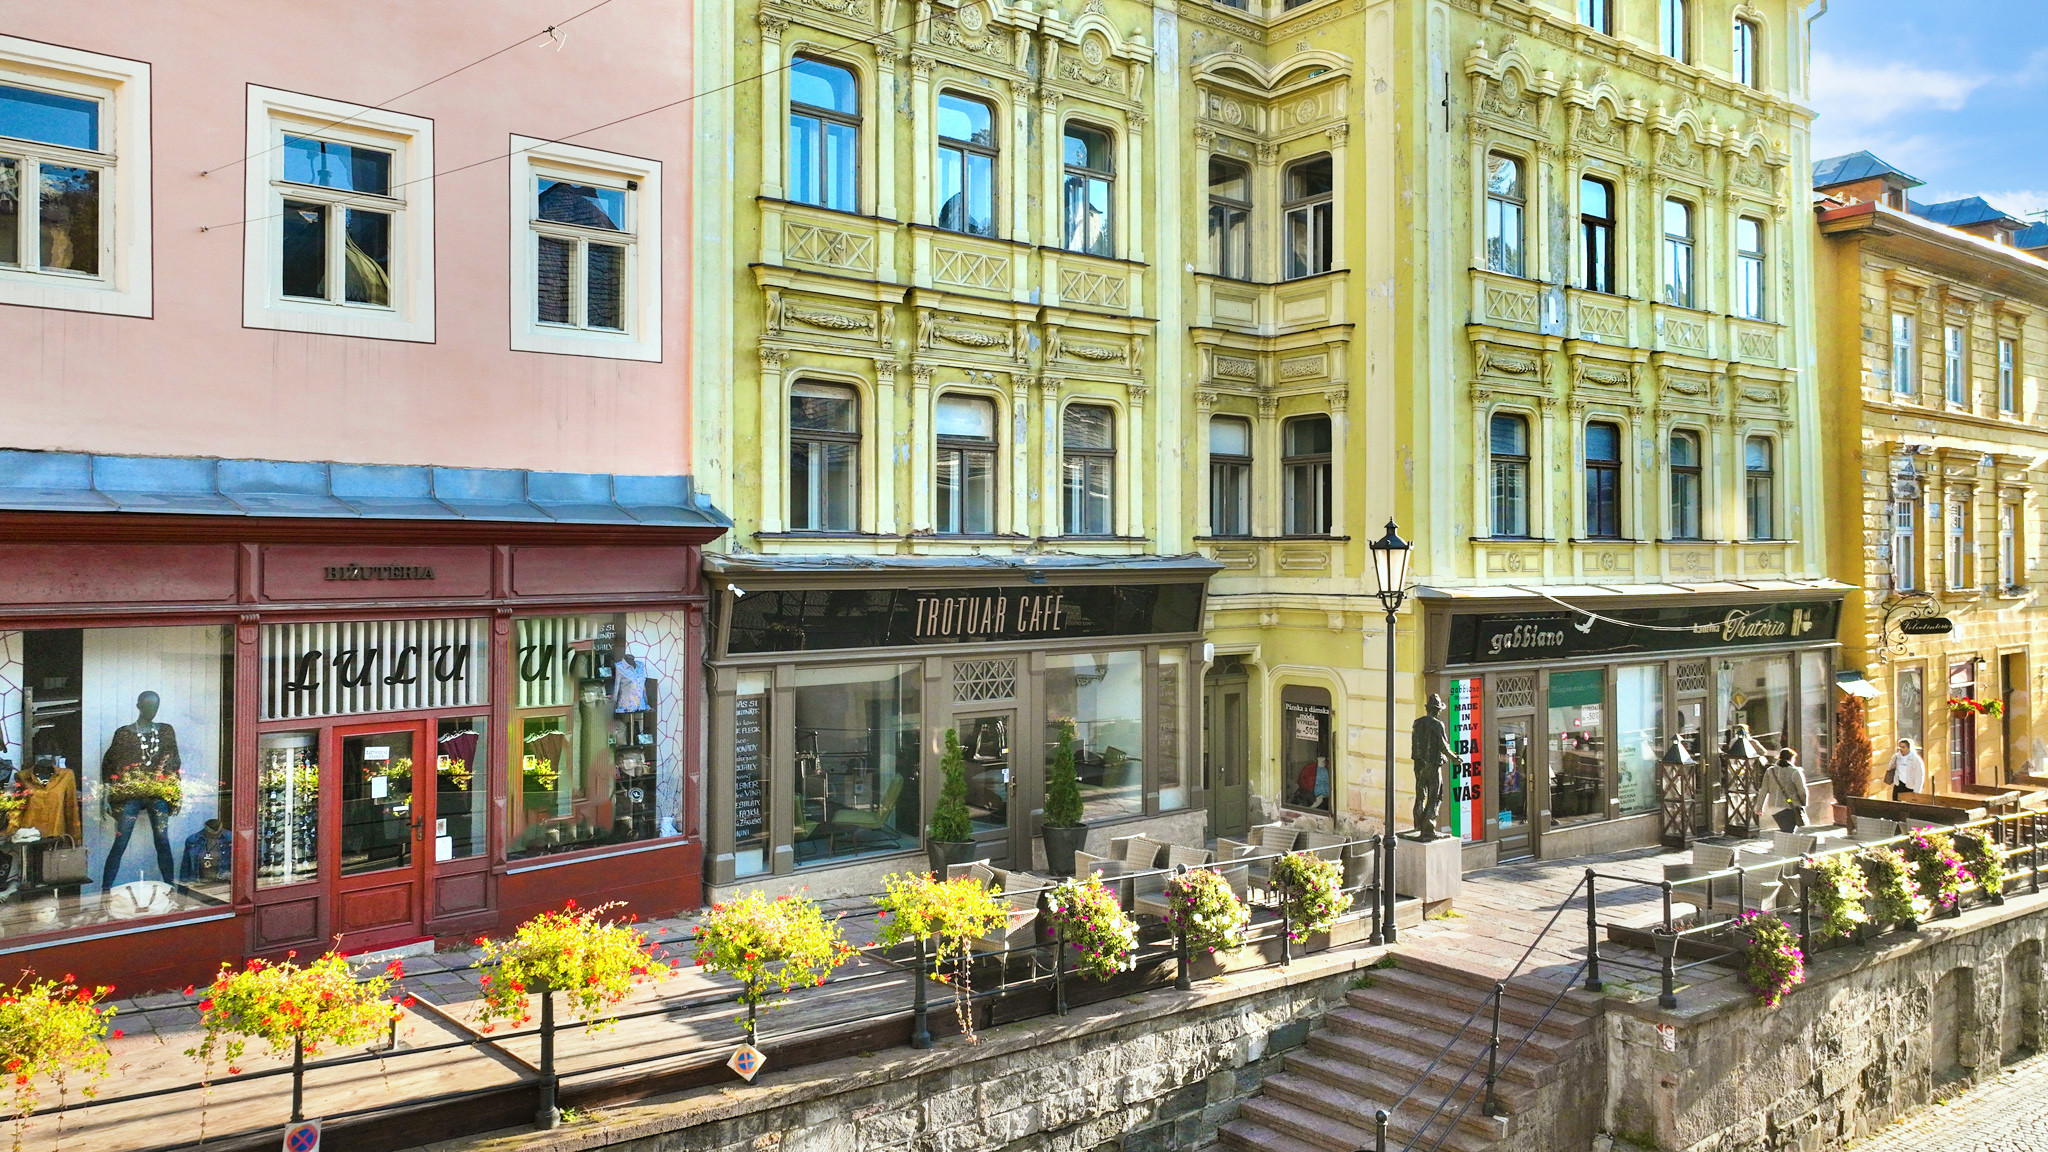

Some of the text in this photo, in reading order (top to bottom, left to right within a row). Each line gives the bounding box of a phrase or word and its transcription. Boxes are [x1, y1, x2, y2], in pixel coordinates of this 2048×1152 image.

[324, 562, 436, 581] BIŽUTÉRIA
[916, 596, 1007, 637] TROTUAR
[1488, 624, 1564, 655] gabbiano
[286, 645, 468, 691] LULU
[1454, 702, 1478, 712] MADE
[1462, 713, 1471, 721] IN
[1454, 722, 1479, 732] ITALY
[1454, 738, 1479, 755] IBA
[1452, 761, 1481, 779] PRE
[1453, 783, 1481, 802] VÁS
